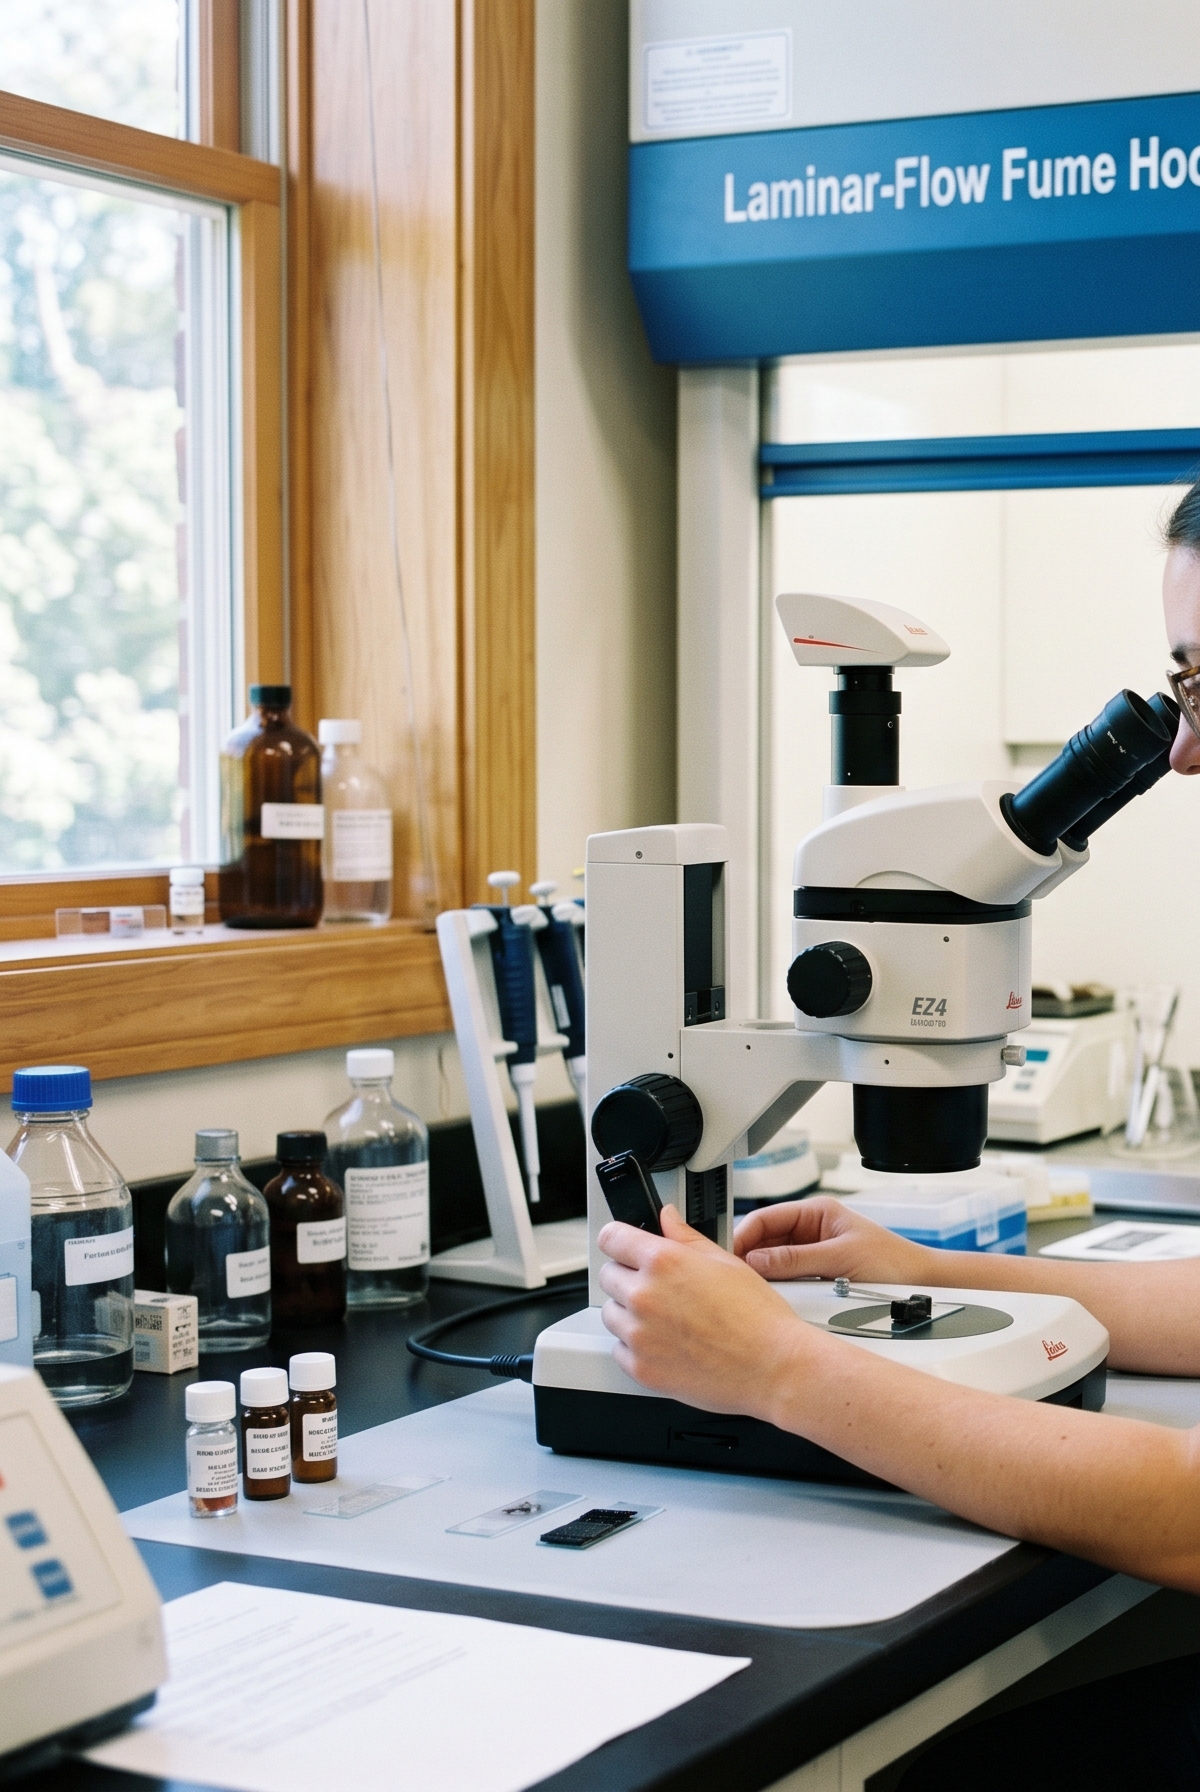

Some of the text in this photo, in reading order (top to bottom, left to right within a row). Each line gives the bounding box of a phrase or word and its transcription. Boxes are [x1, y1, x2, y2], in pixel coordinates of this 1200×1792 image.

[724, 154, 991, 223] Laminar-Flow
[1002, 146, 1117, 201] Fume
[911, 996, 948, 1017] EZ4
